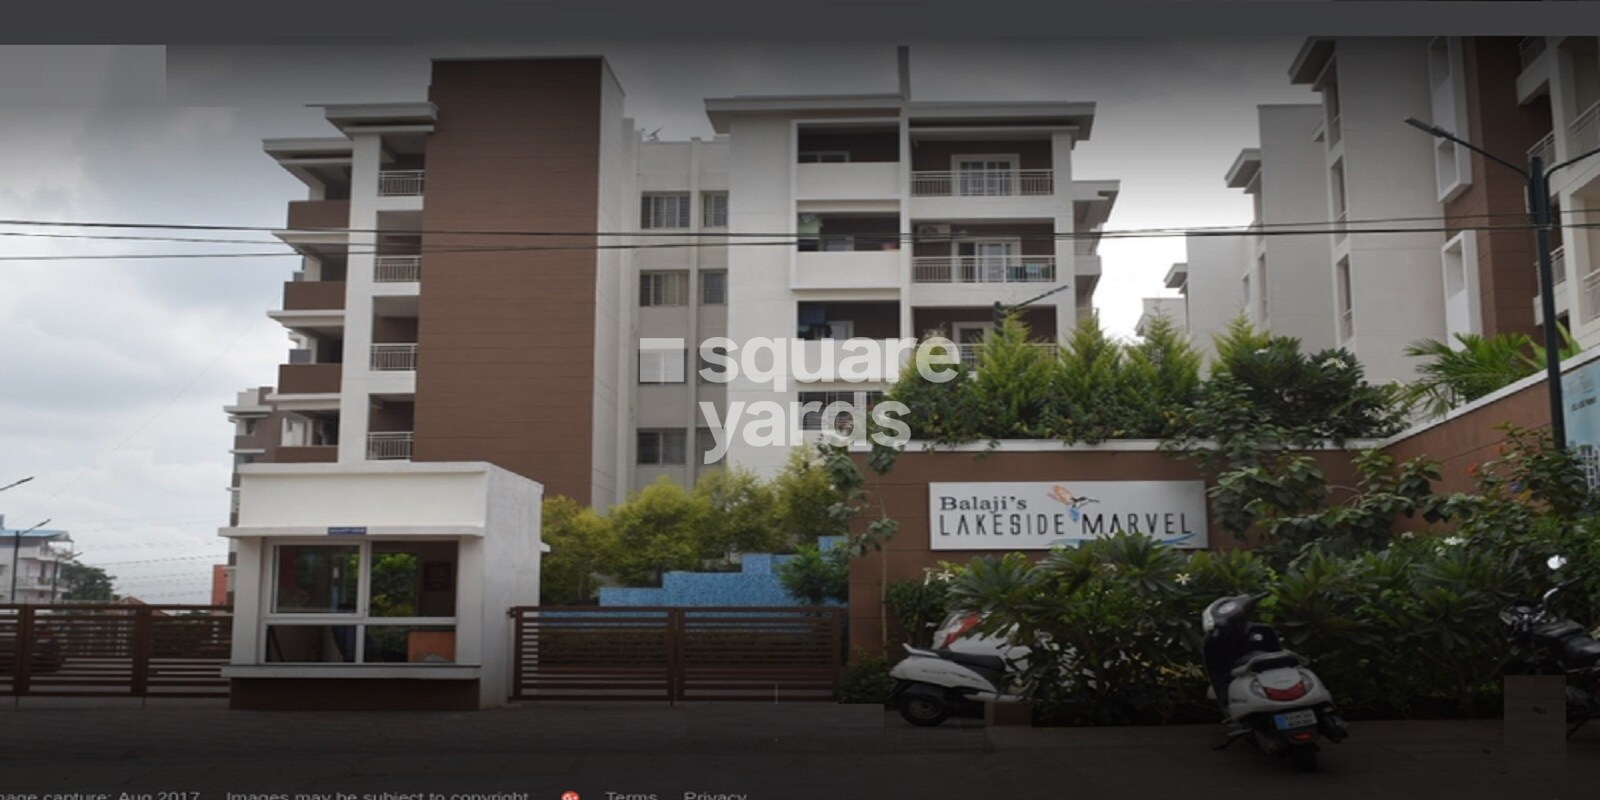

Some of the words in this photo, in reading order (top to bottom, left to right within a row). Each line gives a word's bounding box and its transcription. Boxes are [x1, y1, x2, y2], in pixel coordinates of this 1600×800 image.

[939, 496, 1027, 514] Balaji's
[939, 513, 1064, 535] LAKESIDE
[1082, 513, 1189, 535] MARVEL
